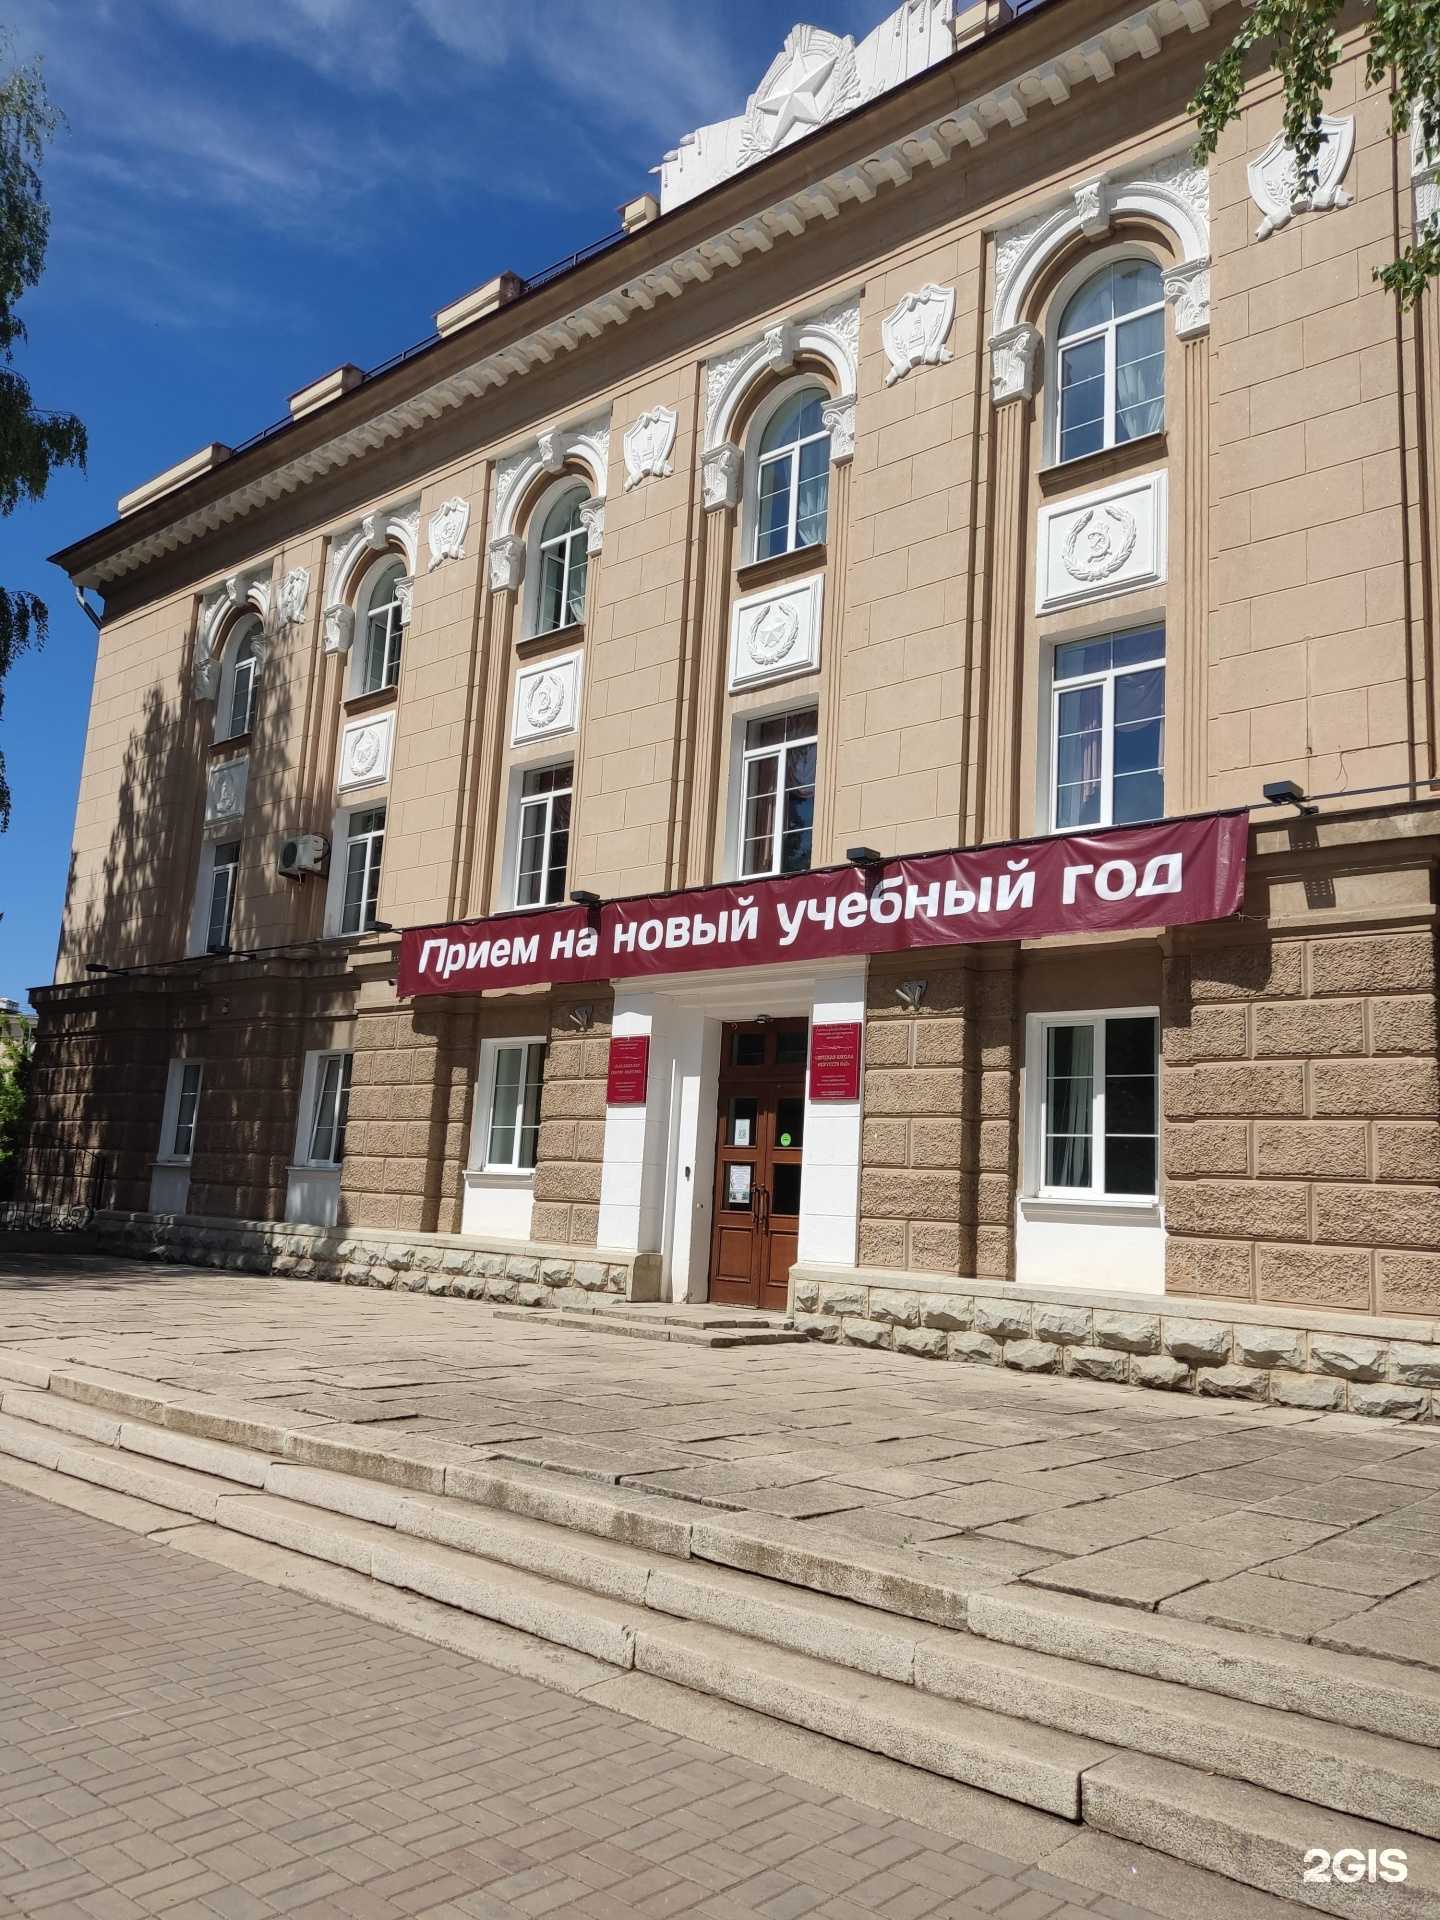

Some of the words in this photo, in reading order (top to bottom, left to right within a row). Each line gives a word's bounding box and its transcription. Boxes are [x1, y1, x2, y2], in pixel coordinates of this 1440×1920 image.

[418, 933, 540, 979] Прием
[550, 927, 599, 960] на
[613, 895, 760, 954] новый
[777, 858, 1036, 945] учебный
[1062, 852, 1183, 902] год
